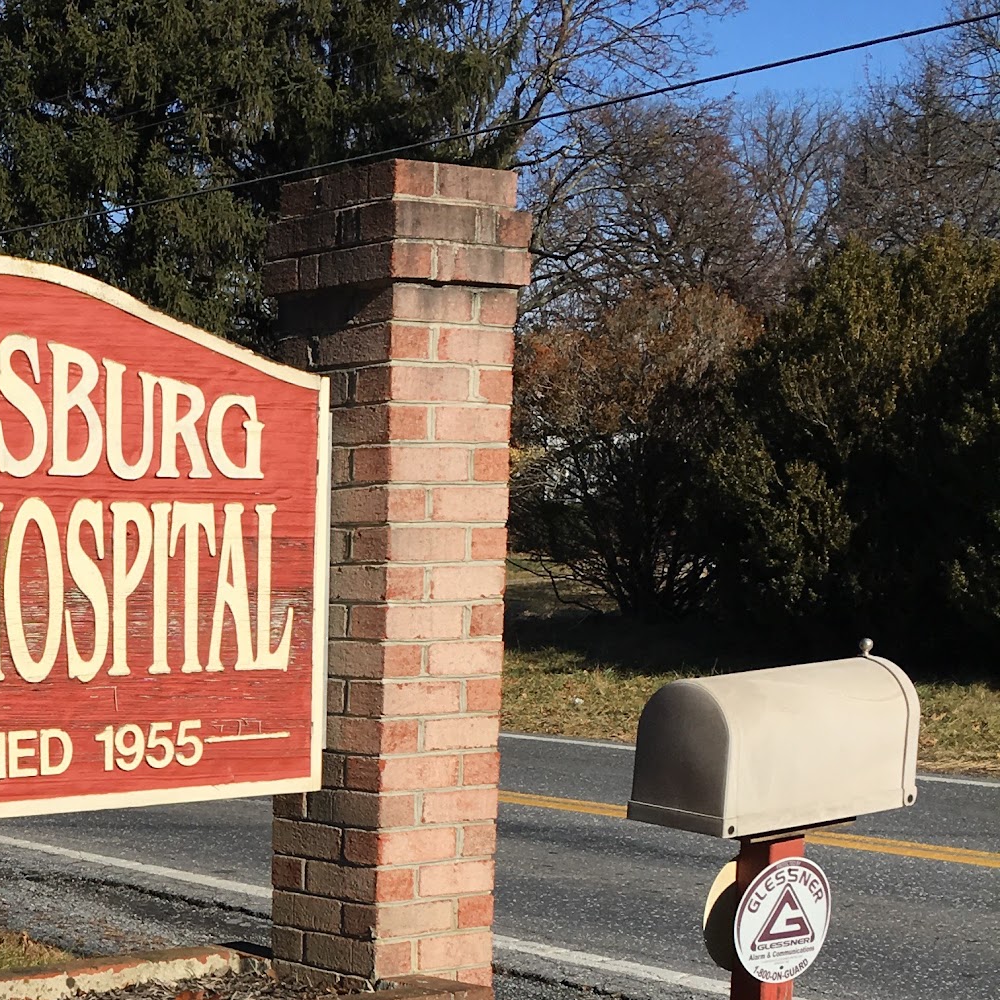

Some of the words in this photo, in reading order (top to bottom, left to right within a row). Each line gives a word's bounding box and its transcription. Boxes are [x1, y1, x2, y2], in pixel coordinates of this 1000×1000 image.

[95, 719, 204, 773] 1955
[747, 868, 824, 913] GLESSNER
[757, 937, 810, 951] GLESSNER
[772, 946, 815, 958] Communications
[753, 958, 808, 980] 1-800-ON-GUARD
